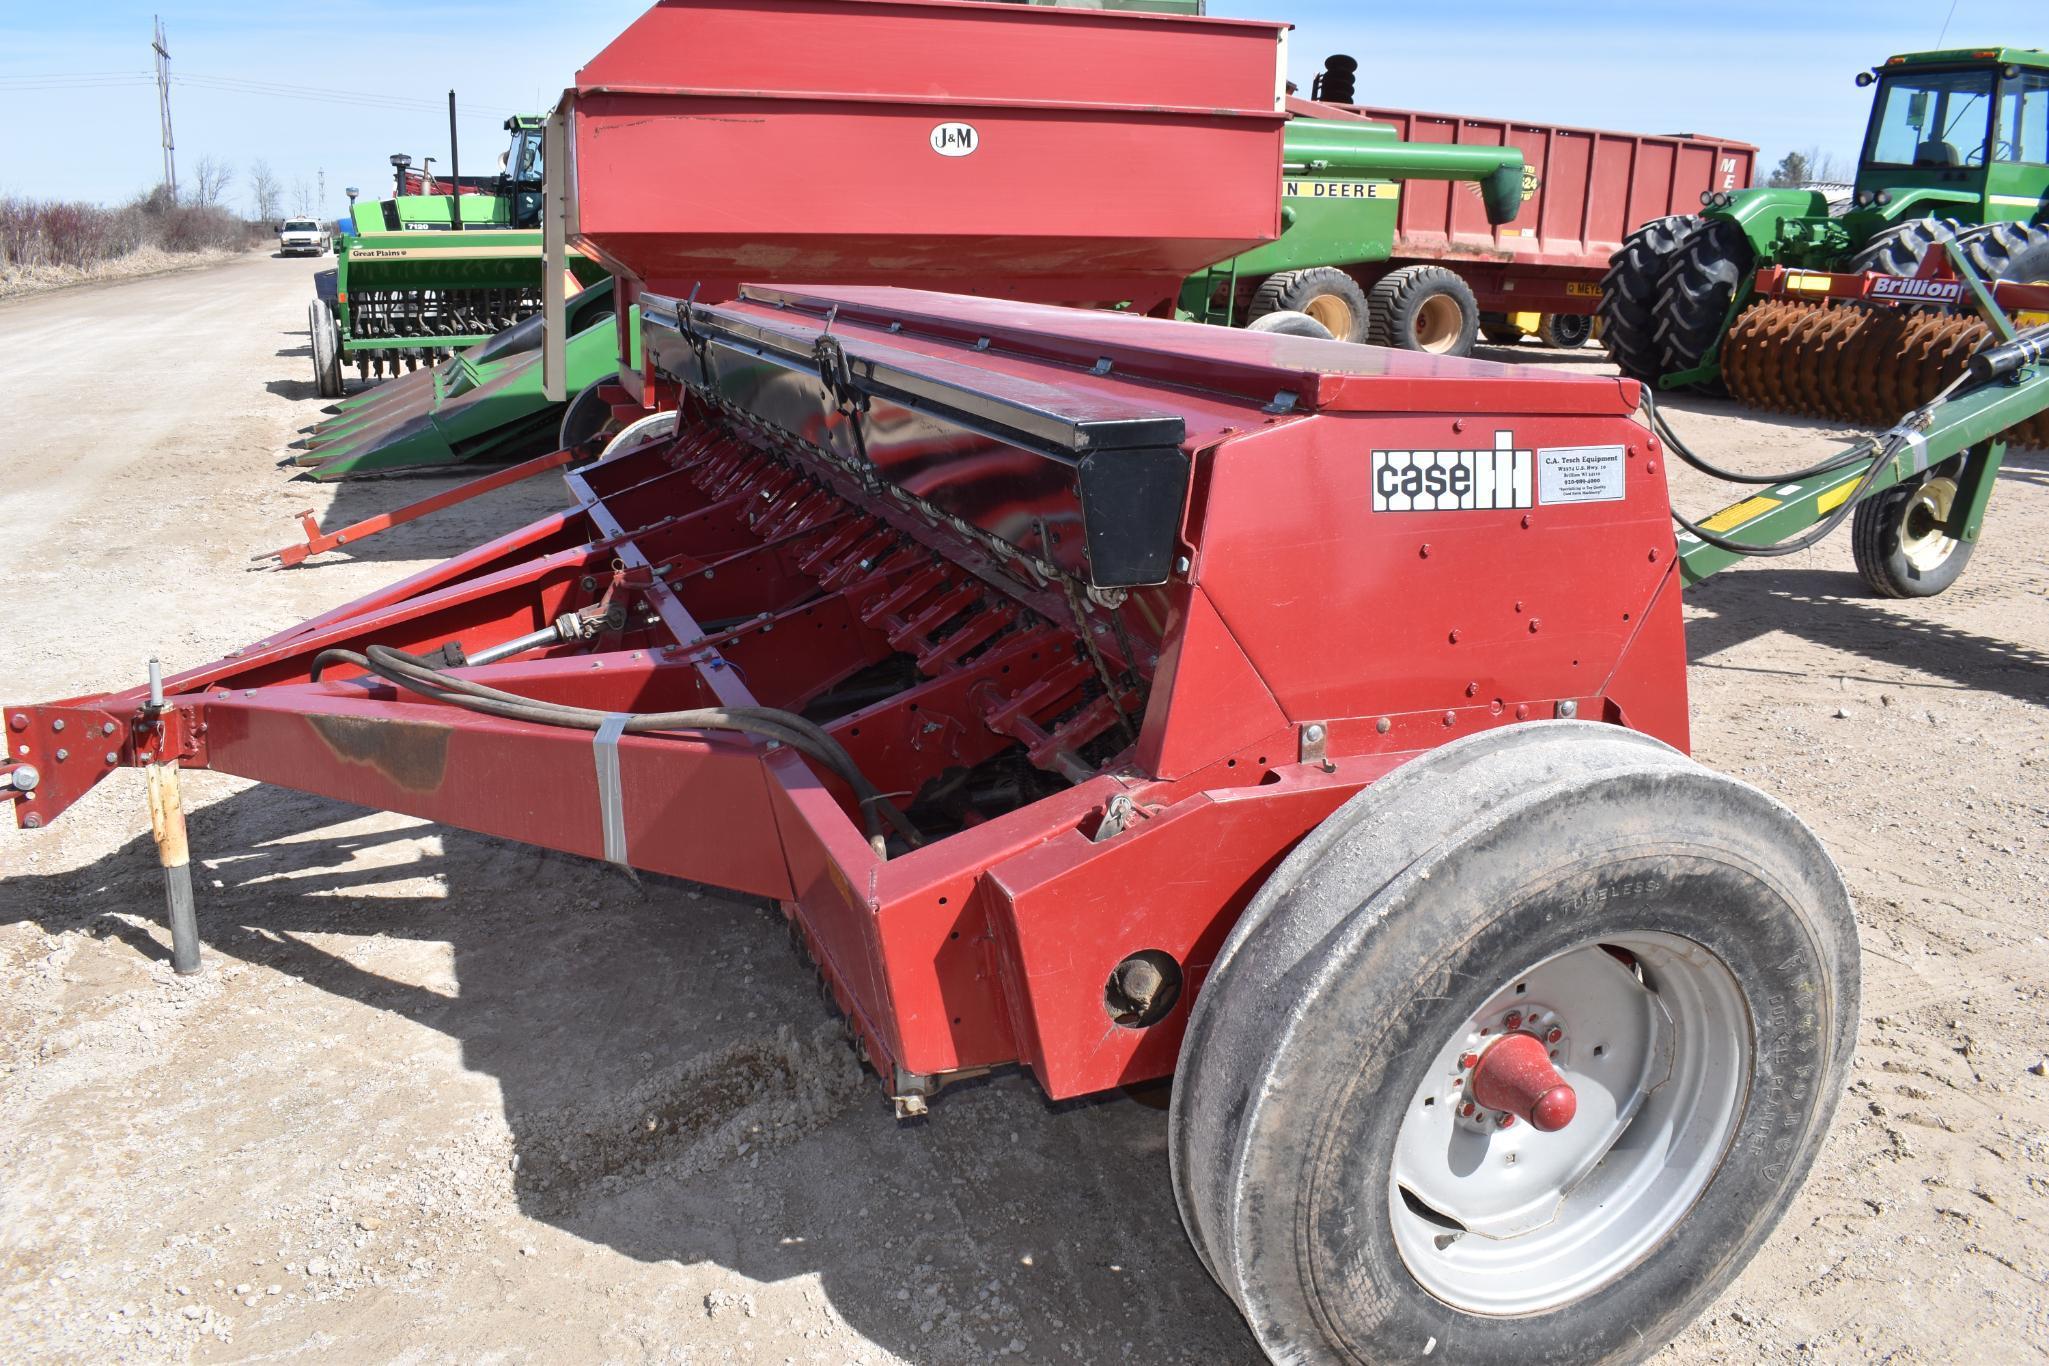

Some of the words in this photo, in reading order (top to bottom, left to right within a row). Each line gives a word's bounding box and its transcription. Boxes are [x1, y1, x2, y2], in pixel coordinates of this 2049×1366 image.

[935, 127, 971, 148] J&M
[1314, 183, 1377, 198] DEERE
[407, 223, 429, 231] 7120
[1873, 276, 1959, 298] Brillion
[1561, 879, 1658, 916] TUBELESS
